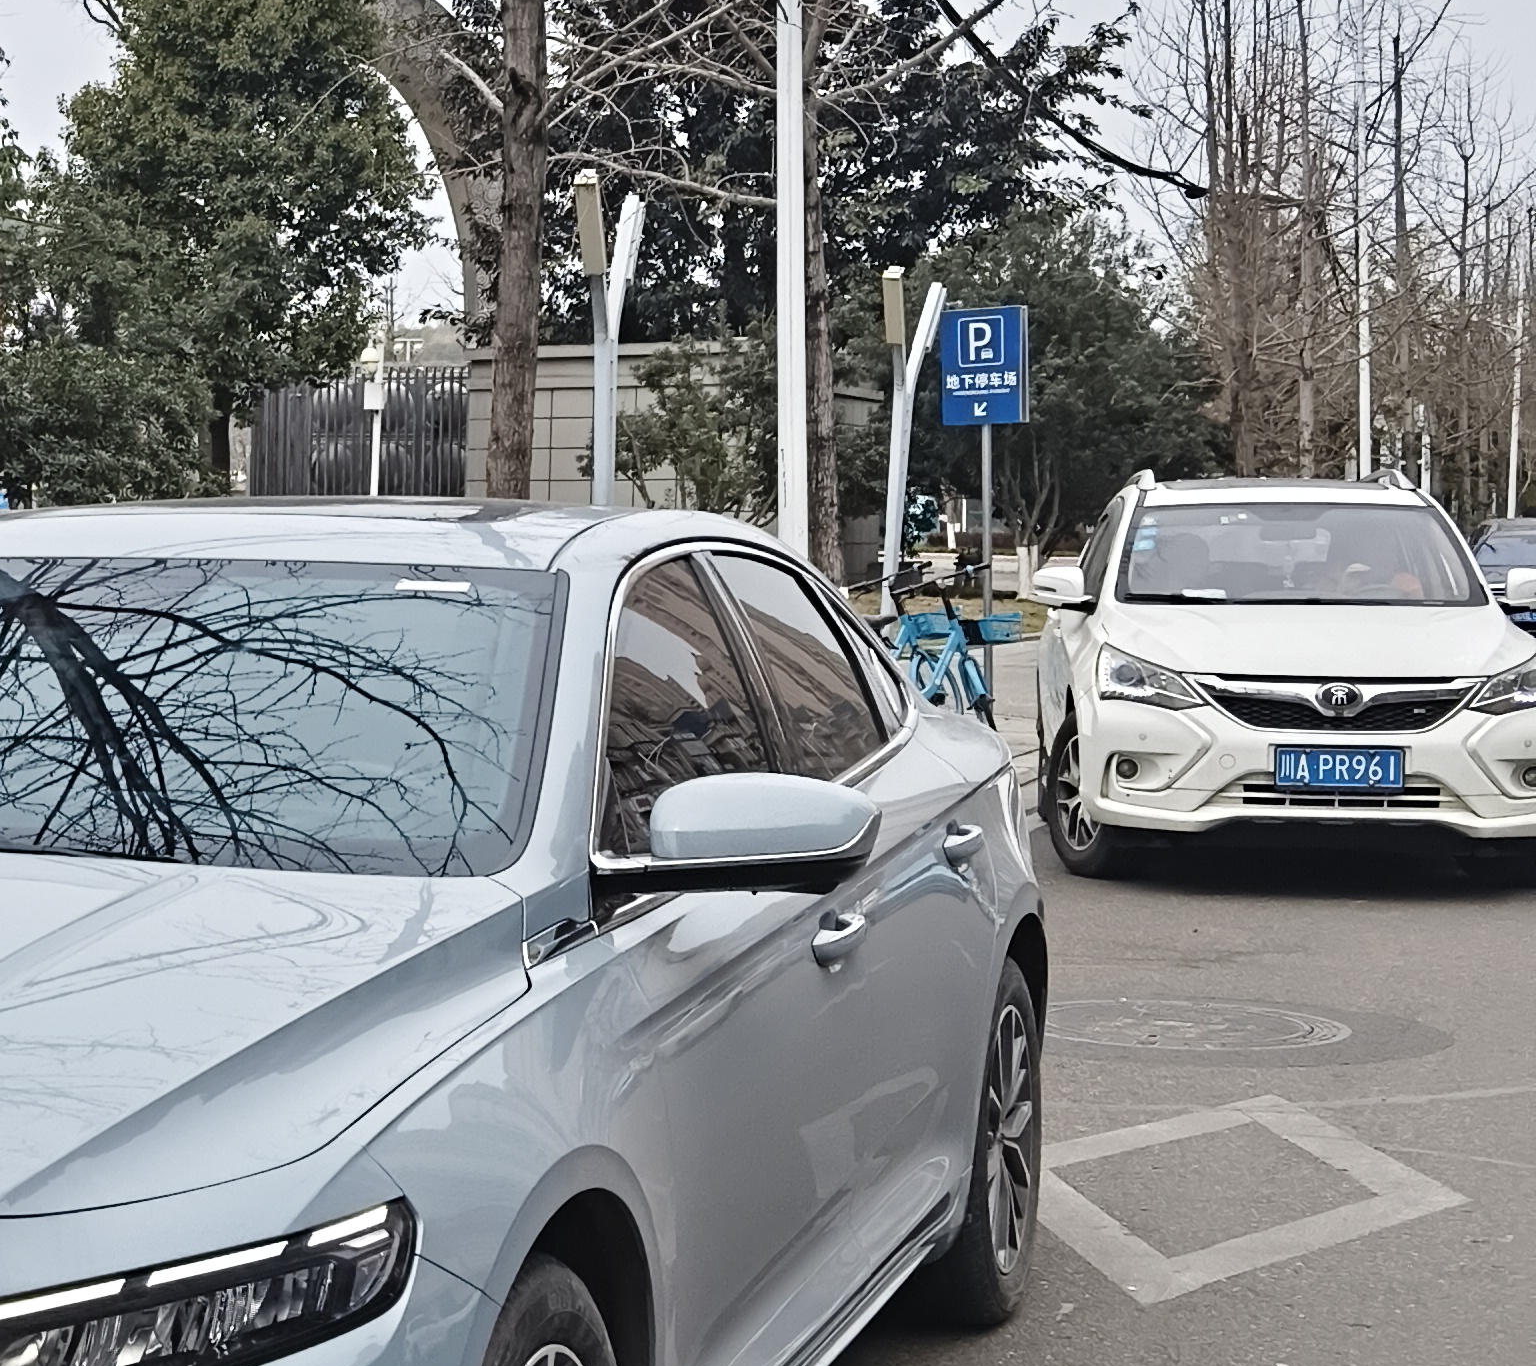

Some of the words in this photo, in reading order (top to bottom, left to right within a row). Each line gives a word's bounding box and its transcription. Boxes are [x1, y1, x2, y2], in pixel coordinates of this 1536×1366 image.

[969, 322, 992, 361] P
[945, 371, 1017, 390] 地下停车场
